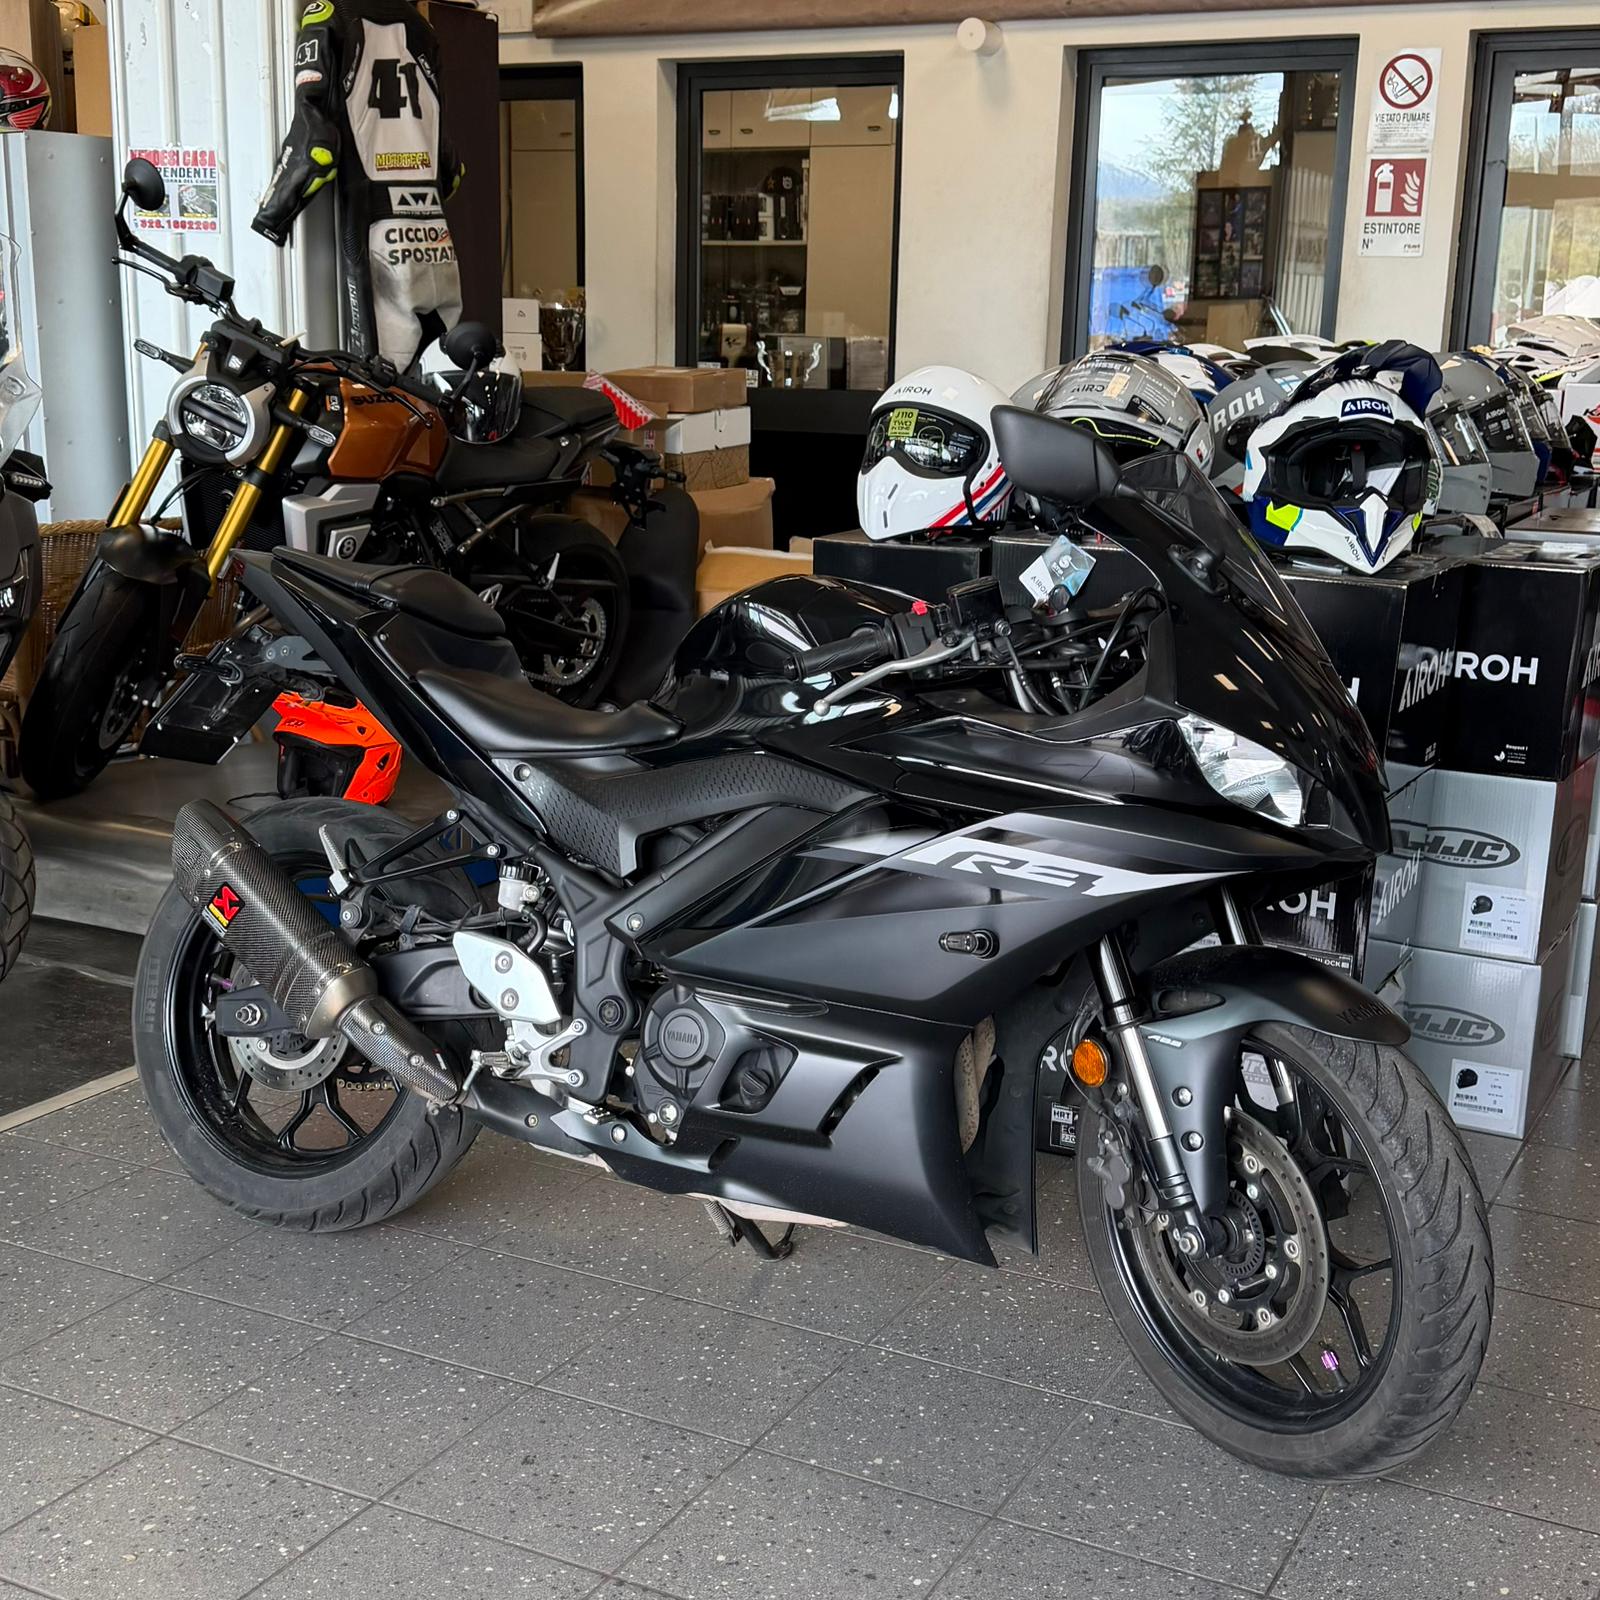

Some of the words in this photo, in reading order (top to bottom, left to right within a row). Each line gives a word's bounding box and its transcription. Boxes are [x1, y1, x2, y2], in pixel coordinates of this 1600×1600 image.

[295, 39, 318, 66] 41
[368, 58, 422, 119] 41
[1375, 113, 1401, 123] VIETATO
[1402, 112, 1430, 122] FUMARE
[183, 150, 216, 167] CASA
[385, 227, 439, 244] CICCIO
[1363, 222, 1420, 234] ESTINTORE
[388, 246, 456, 265] SPOSTAT
[894, 386, 932, 395] AIROH
[1071, 384, 1106, 393] AIRO
[1344, 400, 1392, 414] AIROH
[1344, 535, 1361, 562] AIROH
[1399, 648, 1449, 712] AIROH
[1421, 834, 1504, 861] HJC
[1376, 848, 1421, 926] AIROH
[1407, 1010, 1489, 1040] HJC
[667, 1031, 698, 1044] YAMAHA
